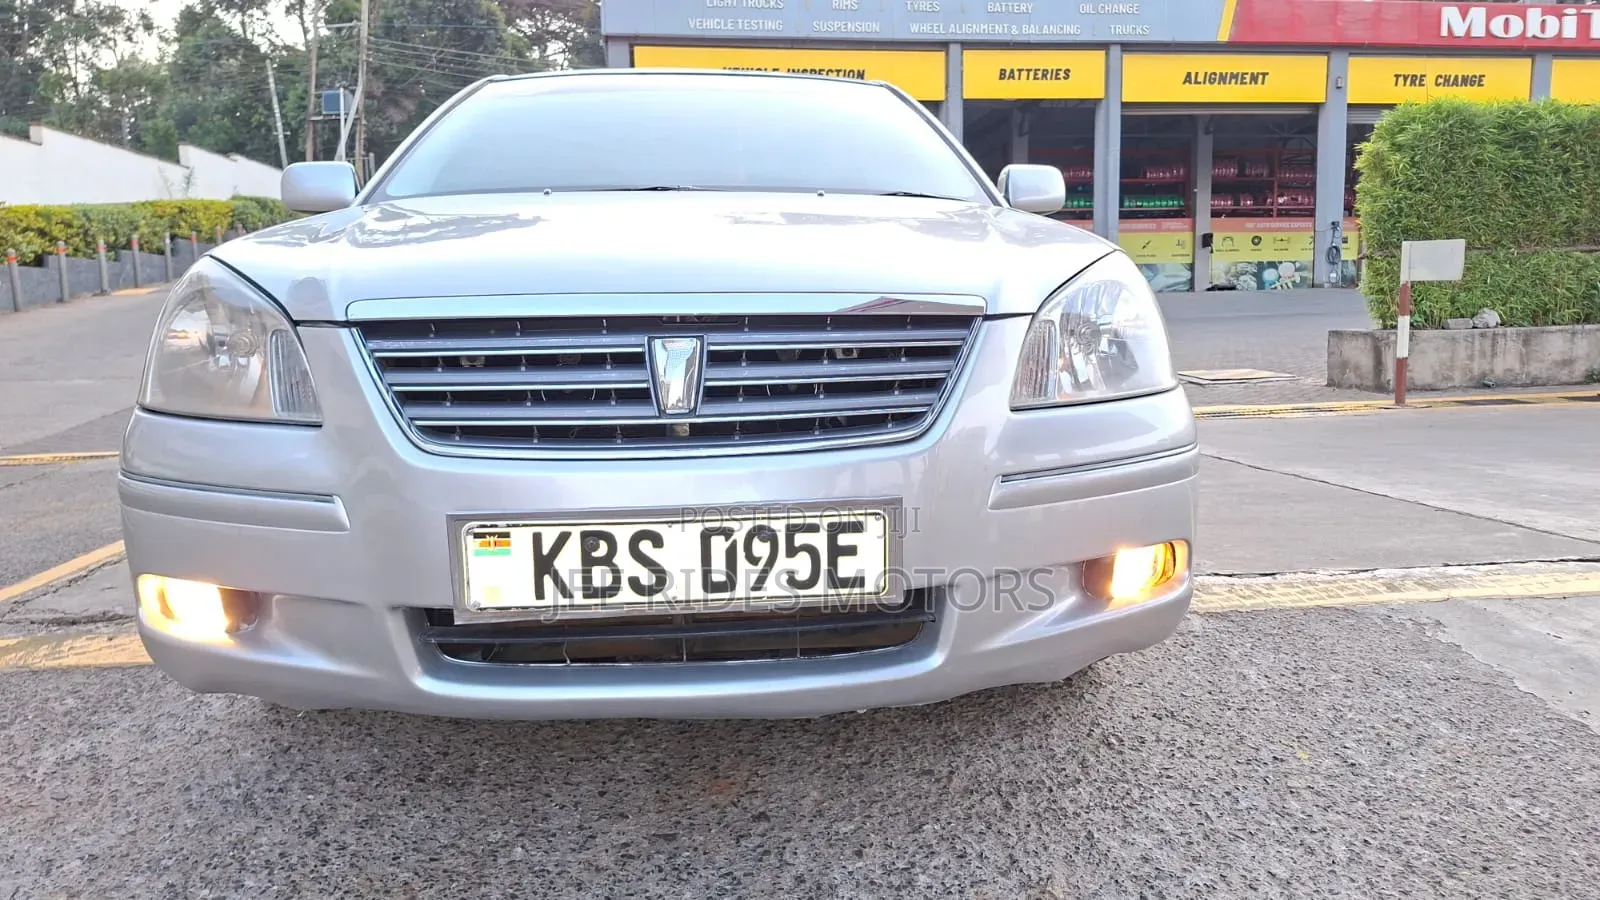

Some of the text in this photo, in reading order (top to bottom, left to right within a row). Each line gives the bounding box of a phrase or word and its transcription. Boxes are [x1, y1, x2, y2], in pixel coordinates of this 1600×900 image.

[706, 0, 784, 9] LIGHT TRUCKS
[832, 0, 858, 10] RIMS
[907, 2, 940, 12] TYRES
[987, 2, 1033, 13] BATTERY
[1079, 3, 1140, 15] OIL CHANGE
[688, 18, 783, 31] VEHICLE TESTING
[812, 20, 880, 33] SUSPENSION
[910, 23, 1081, 36] WHEEL ALIGNMENT & BALANCING
[1110, 24, 1149, 36] TRUCKS
[998, 68, 1071, 81] BATTERIES
[1182, 72, 1269, 86] ALIGNMENT
[1393, 74, 1485, 88] TYRE CHANGE
[532, 529, 667, 600] KBS
